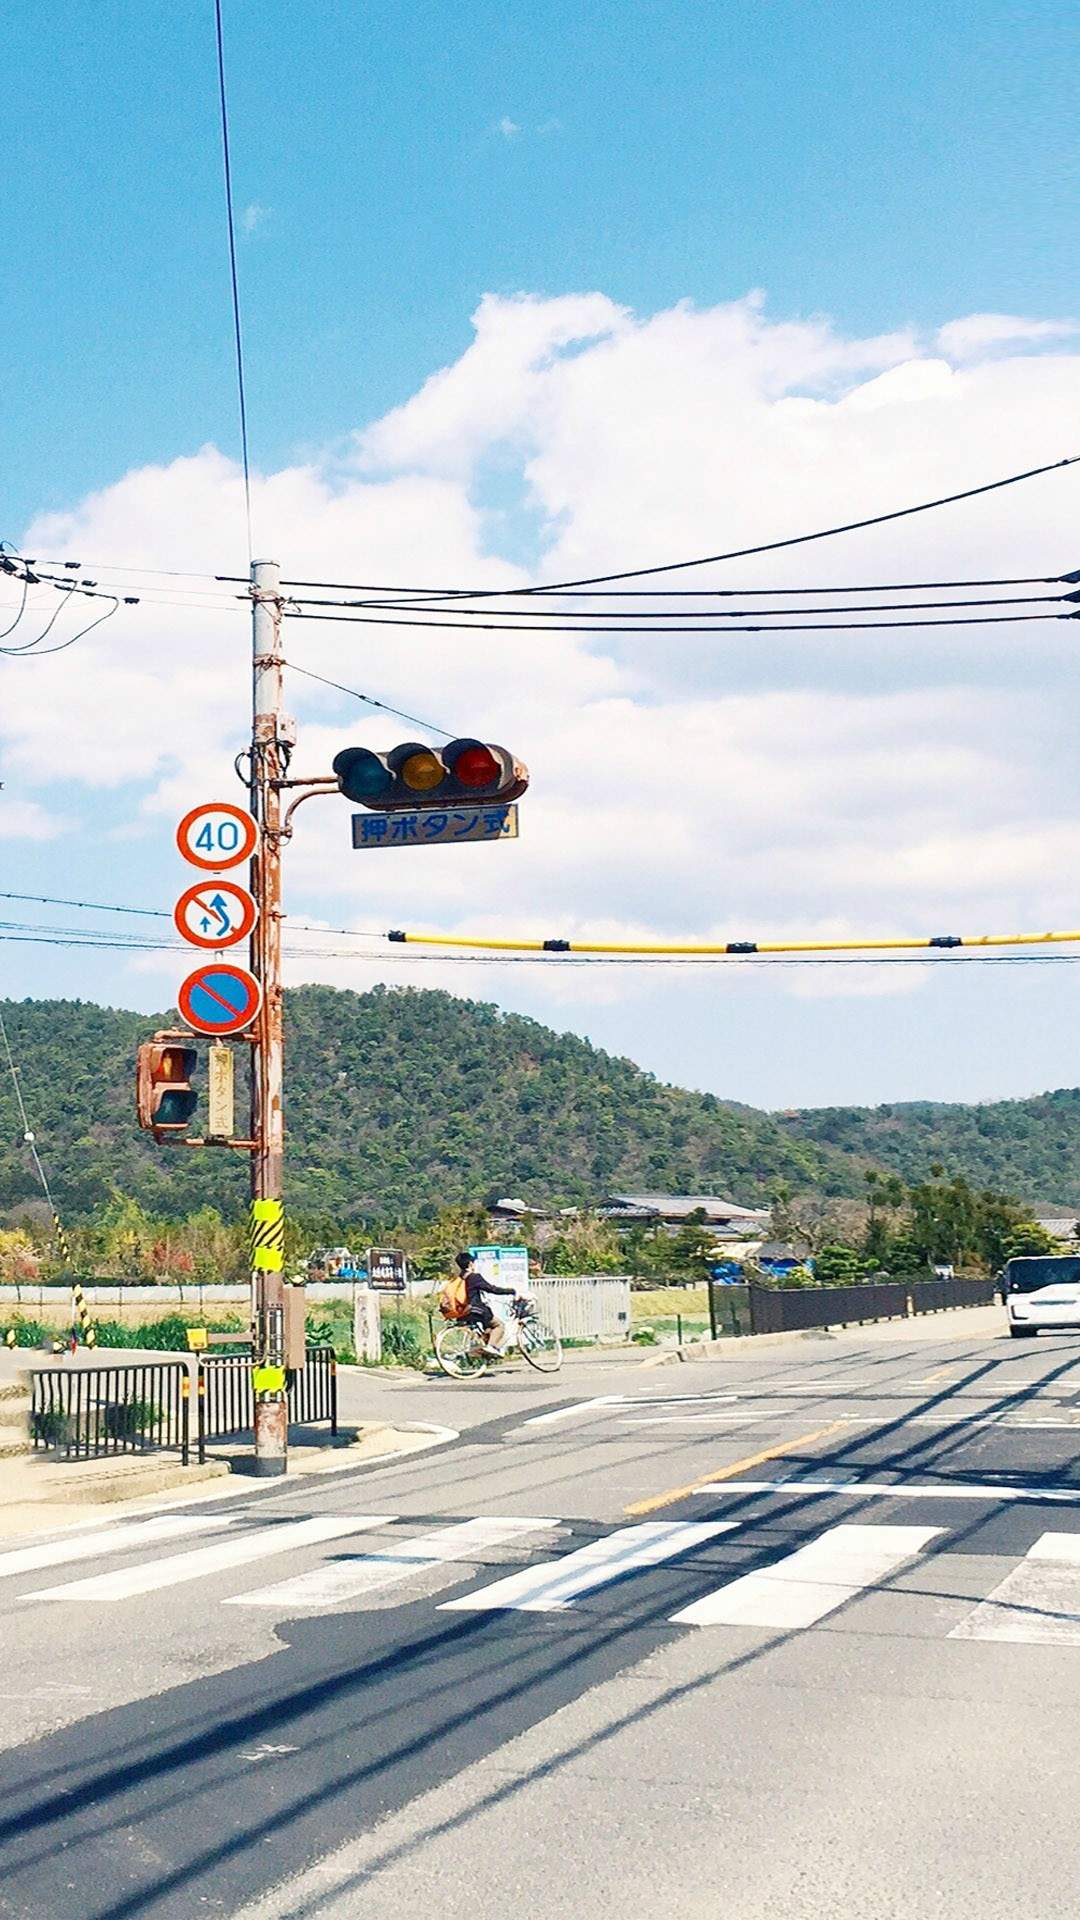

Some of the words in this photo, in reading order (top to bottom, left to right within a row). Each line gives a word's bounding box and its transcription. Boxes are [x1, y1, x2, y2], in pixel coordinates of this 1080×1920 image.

[195, 822, 238, 851] 40
[361, 809, 511, 843] 押ボタン式
